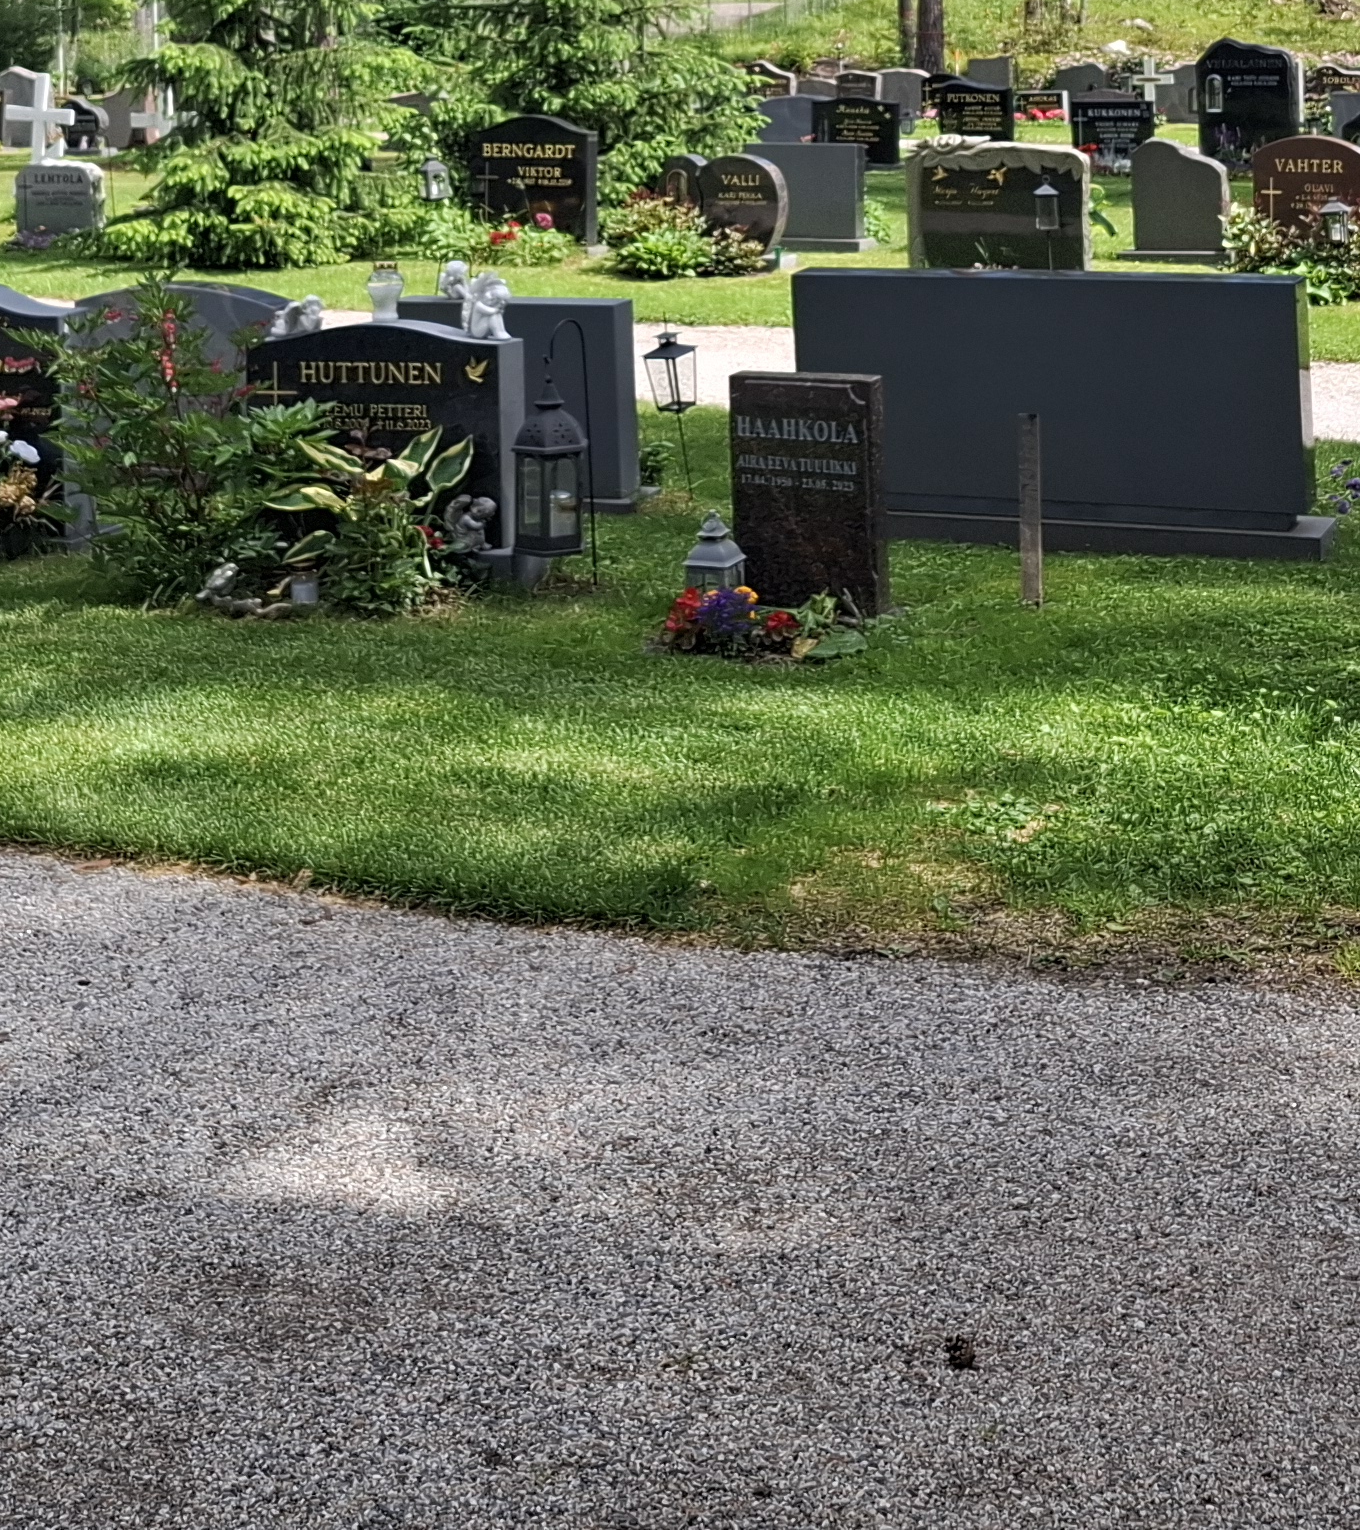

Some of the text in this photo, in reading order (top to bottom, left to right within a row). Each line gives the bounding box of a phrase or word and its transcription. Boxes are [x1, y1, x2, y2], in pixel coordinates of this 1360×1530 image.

[1087, 109, 1141, 117] KUKKONEN
[482, 143, 576, 159] BERNGARDT
[517, 166, 562, 178] VIKTOR
[1274, 158, 1344, 174] VAHTER
[721, 174, 759, 186] VALLI
[300, 361, 442, 385] HUTTUNEN
[370, 404, 428, 418] PETTERI
[736, 415, 858, 443] HAAHKOLA
[799, 458, 857, 475] TUULIKKI
